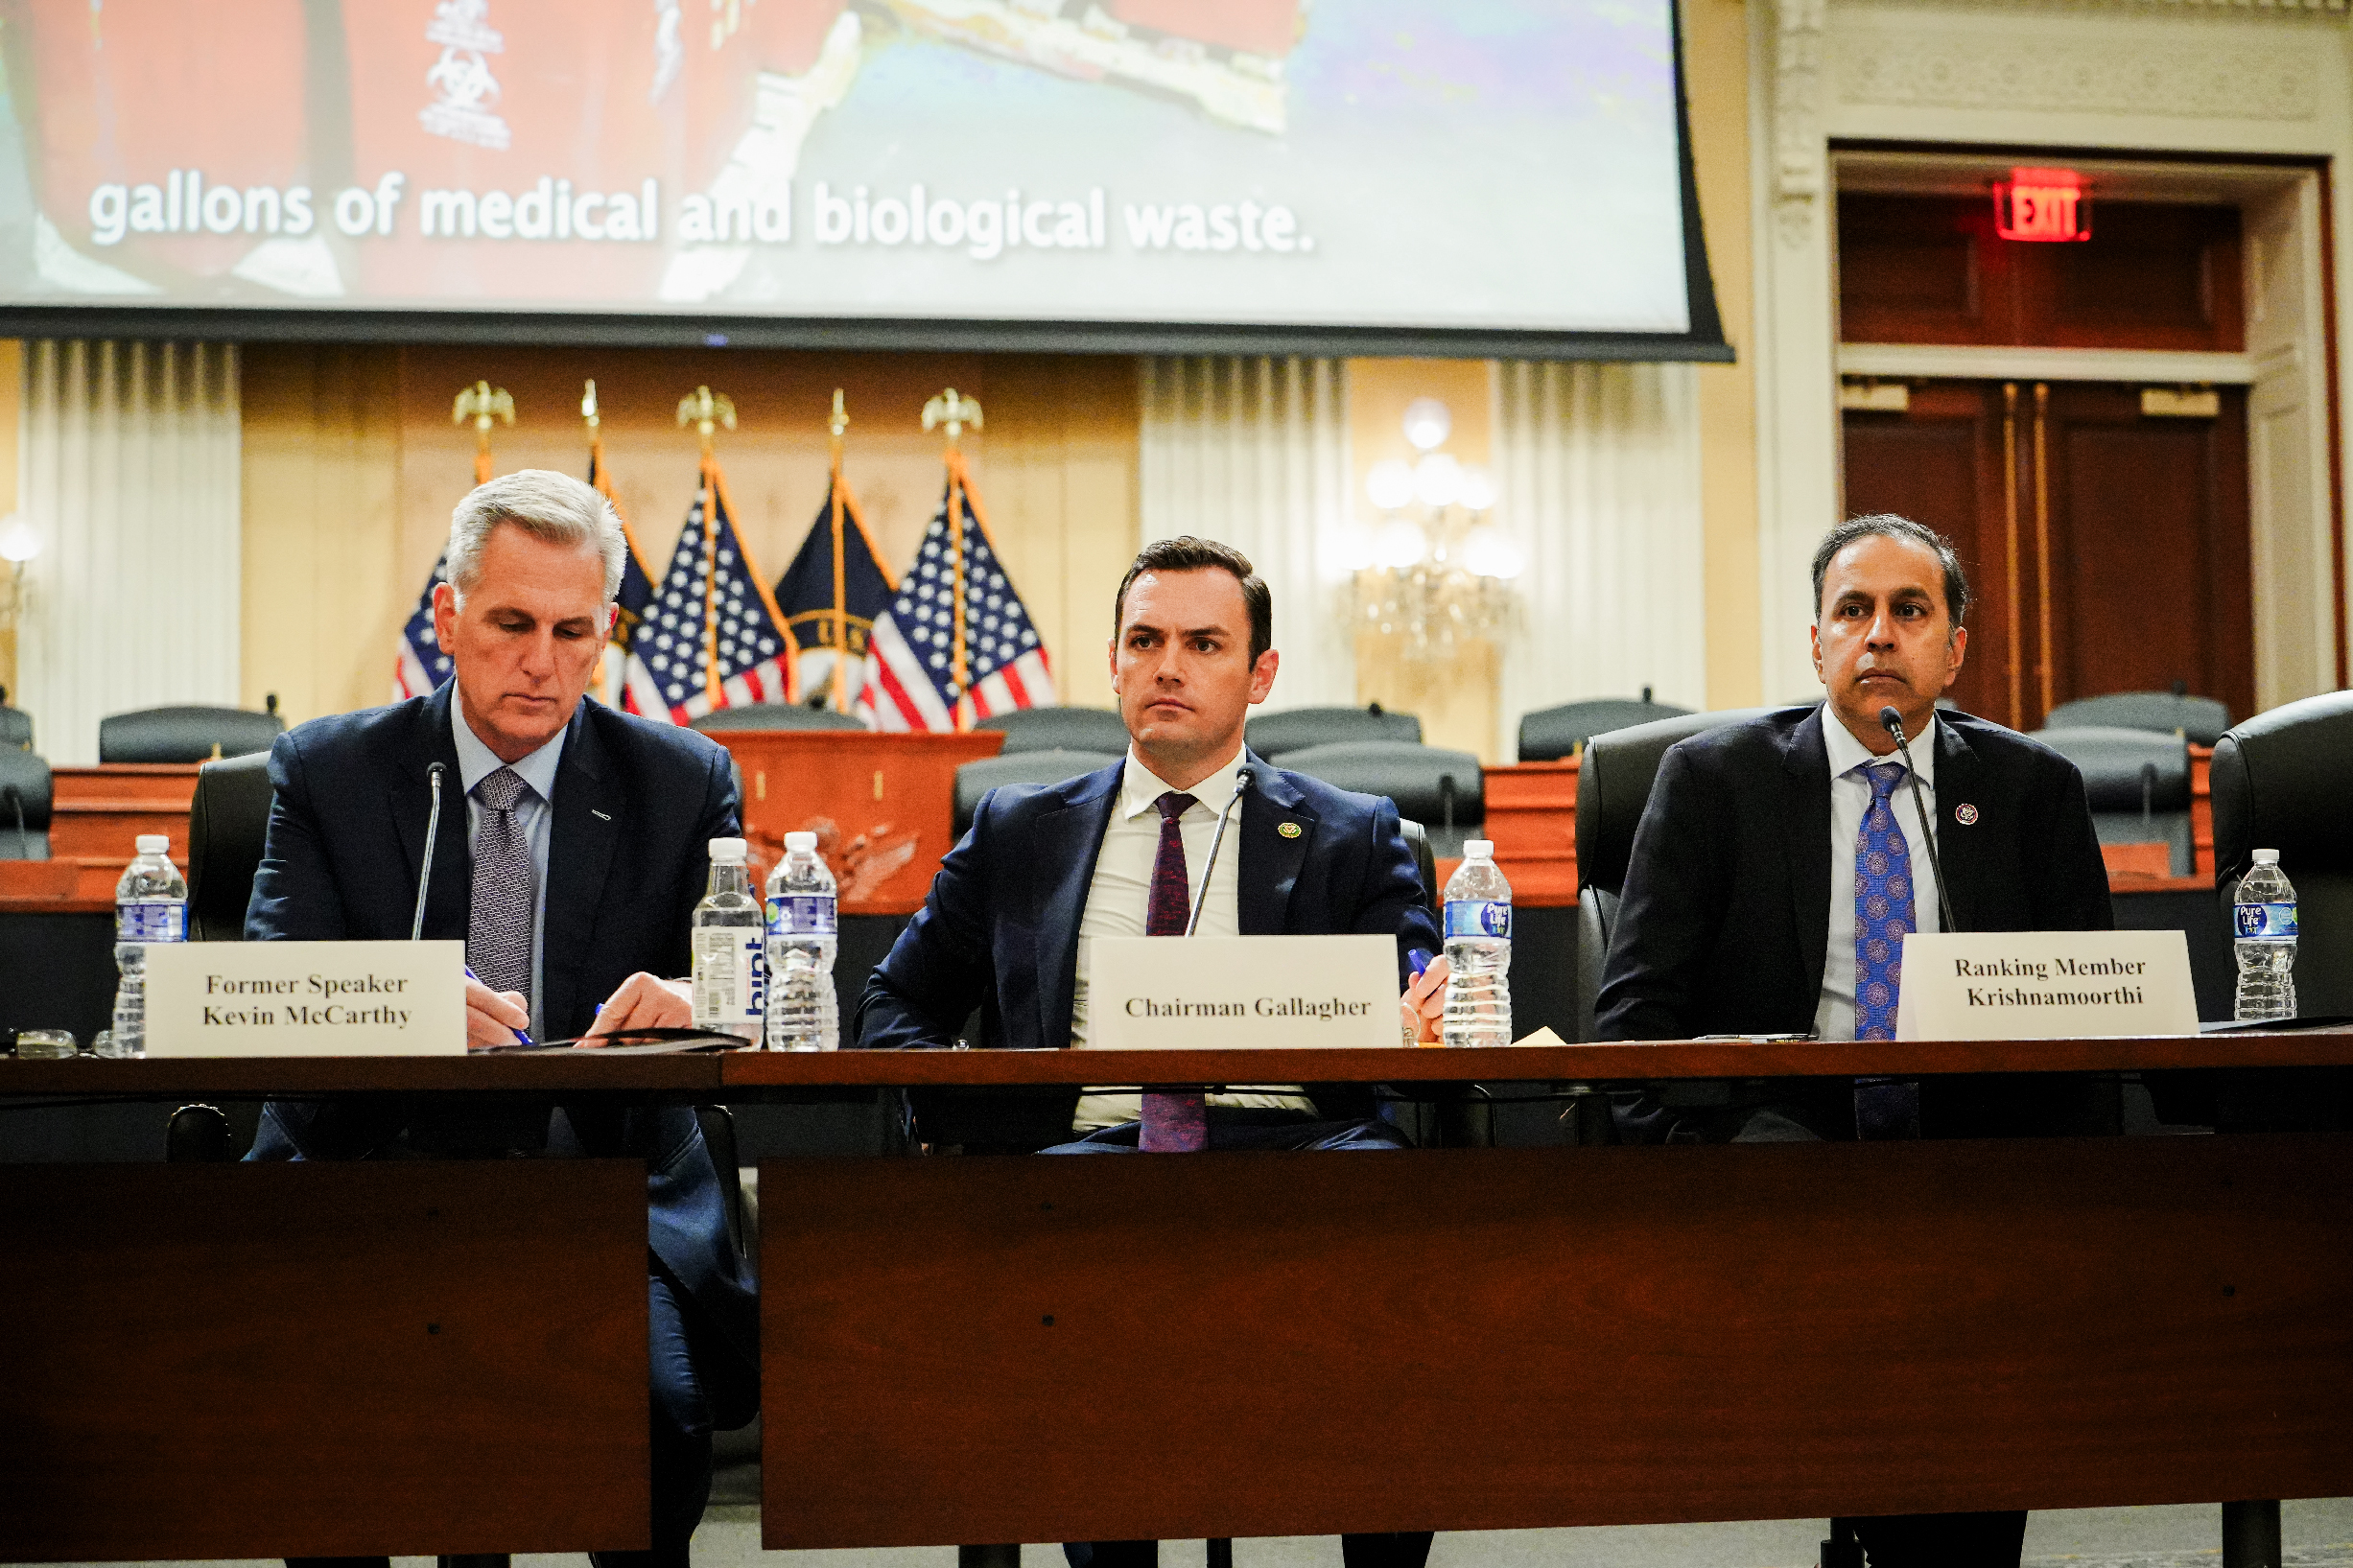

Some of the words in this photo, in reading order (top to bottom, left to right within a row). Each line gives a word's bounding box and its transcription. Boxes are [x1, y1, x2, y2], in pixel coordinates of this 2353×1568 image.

[88, 169, 315, 246] gallons
[334, 171, 407, 237] of
[419, 176, 659, 241] medical
[677, 178, 792, 243] and
[813, 182, 1105, 260] biological
[1124, 198, 1315, 252] waste.
[2012, 186, 2081, 236] EXIT
[1487, 902, 1508, 914] Pure
[1490, 913, 1506, 927] Life
[2240, 906, 2261, 916] Pure
[2242, 915, 2259, 926] Life
[745, 937, 763, 1016] hint
[1954, 958, 2048, 981] Ranking
[2055, 957, 2146, 976] Member
[205, 974, 299, 995] Former
[306, 973, 409, 998] Speaker
[1966, 986, 2144, 1007] Krishnamoorthi
[202, 1005, 275, 1025] Kevin
[285, 1004, 412, 1029] McCarthy
[1125, 996, 1246, 1018] Chairman
[1254, 996, 1372, 1021] Gallagher
